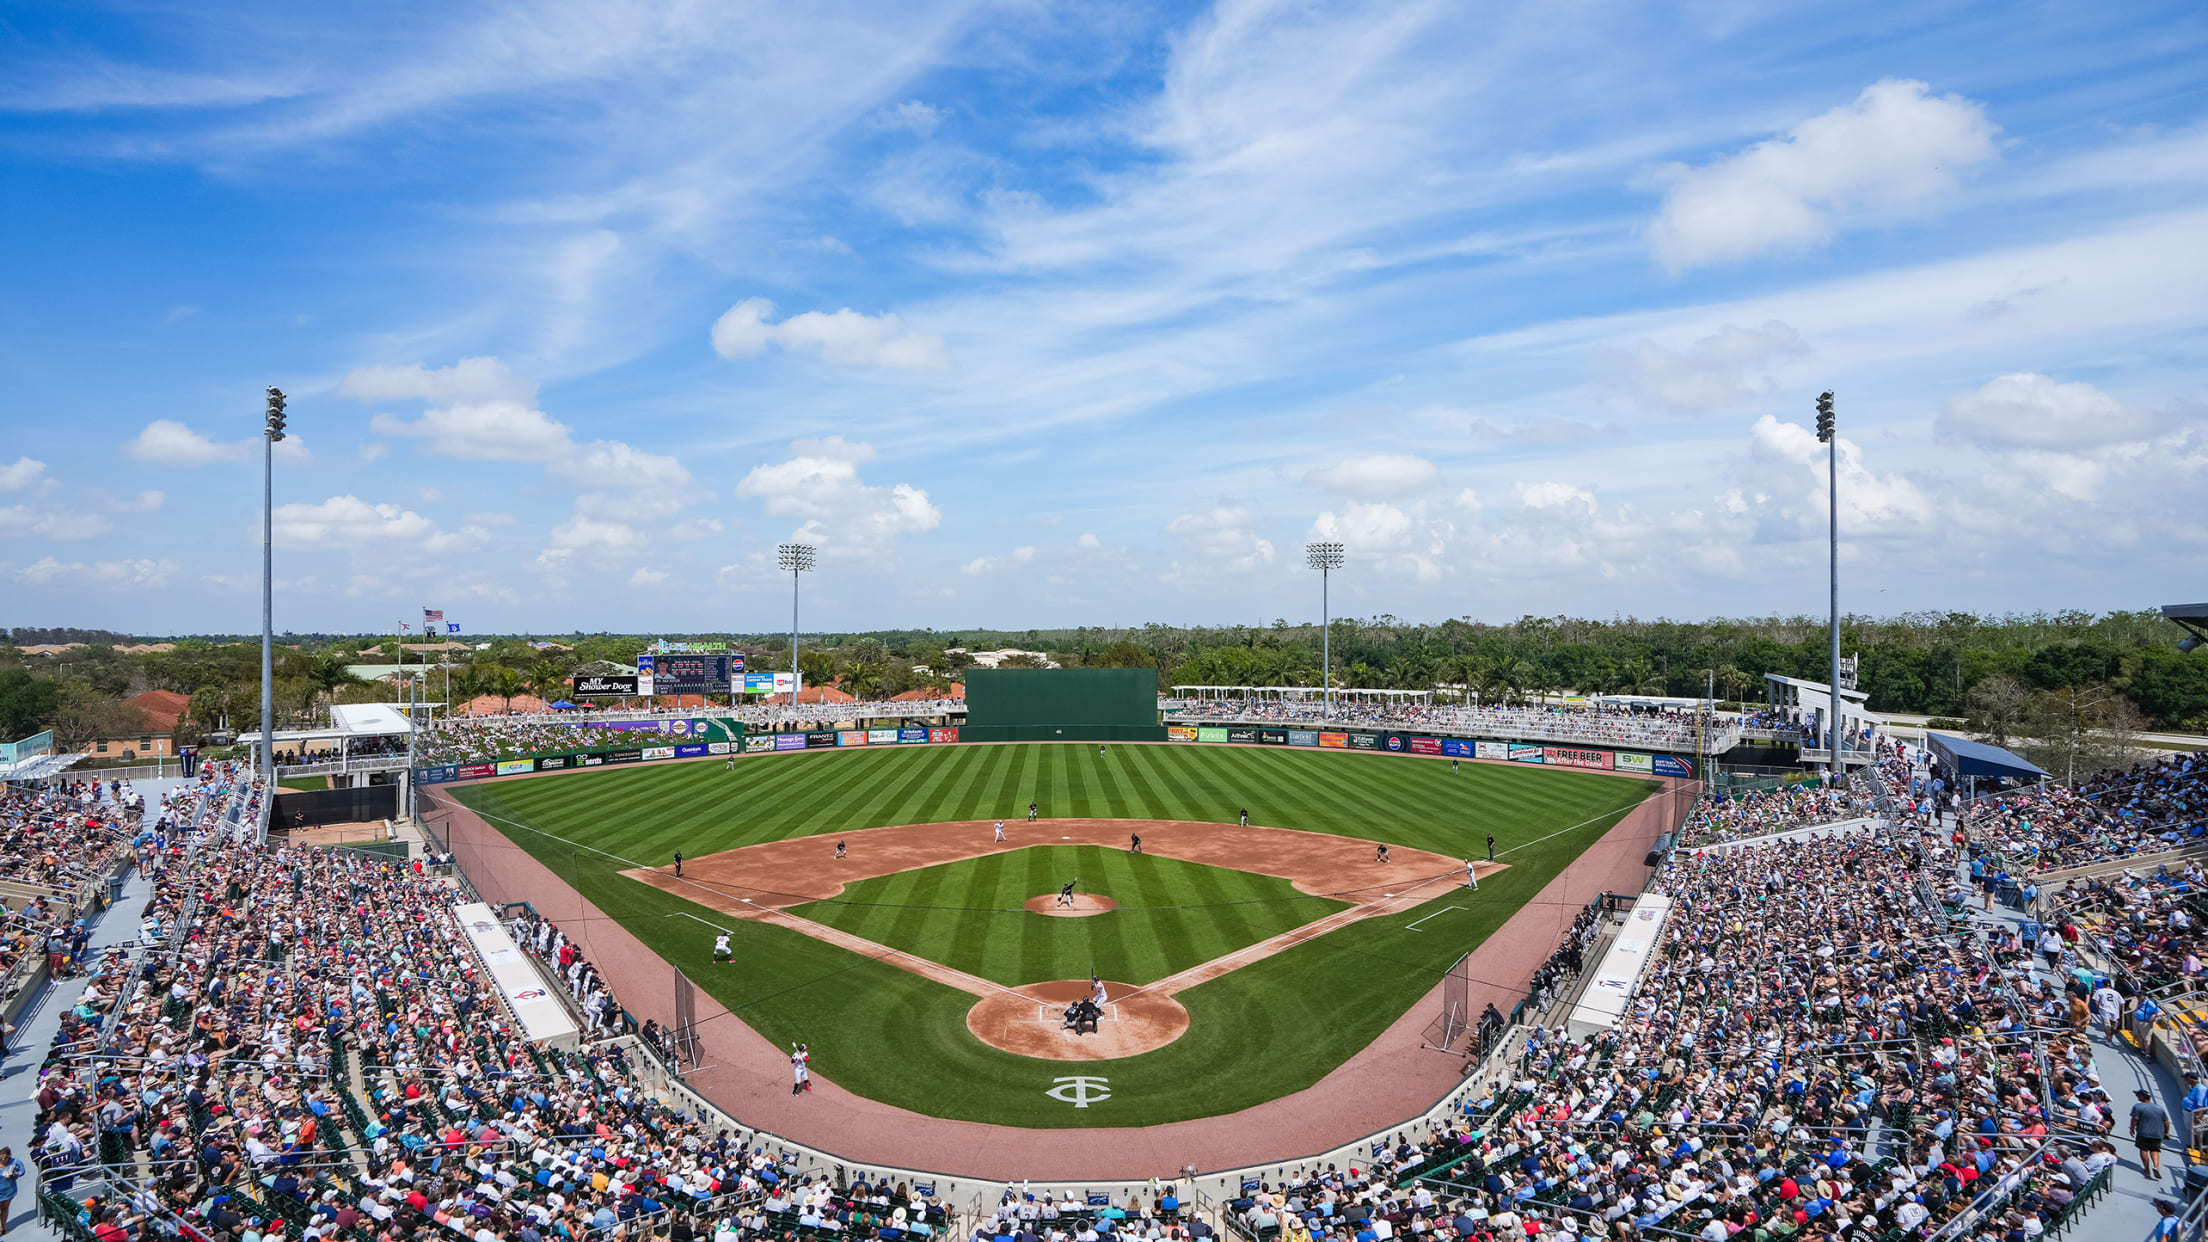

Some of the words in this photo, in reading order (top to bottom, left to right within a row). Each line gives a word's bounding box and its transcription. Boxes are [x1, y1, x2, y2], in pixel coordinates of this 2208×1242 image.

[669, 642, 687, 650] LEE
[689, 642, 726, 650] HEALTH
[579, 682, 611, 691] Shower
[612, 682, 632, 690] Door
[1557, 750, 1578, 760] FREE
[1580, 752, 1602, 761] BEER
[1622, 754, 1645, 764] SW
[585, 757, 602, 765] nerds
[1556, 757, 1571, 765] After
[2107, 993, 2113, 1002] 2
[56, 1154, 69, 1163] 111
